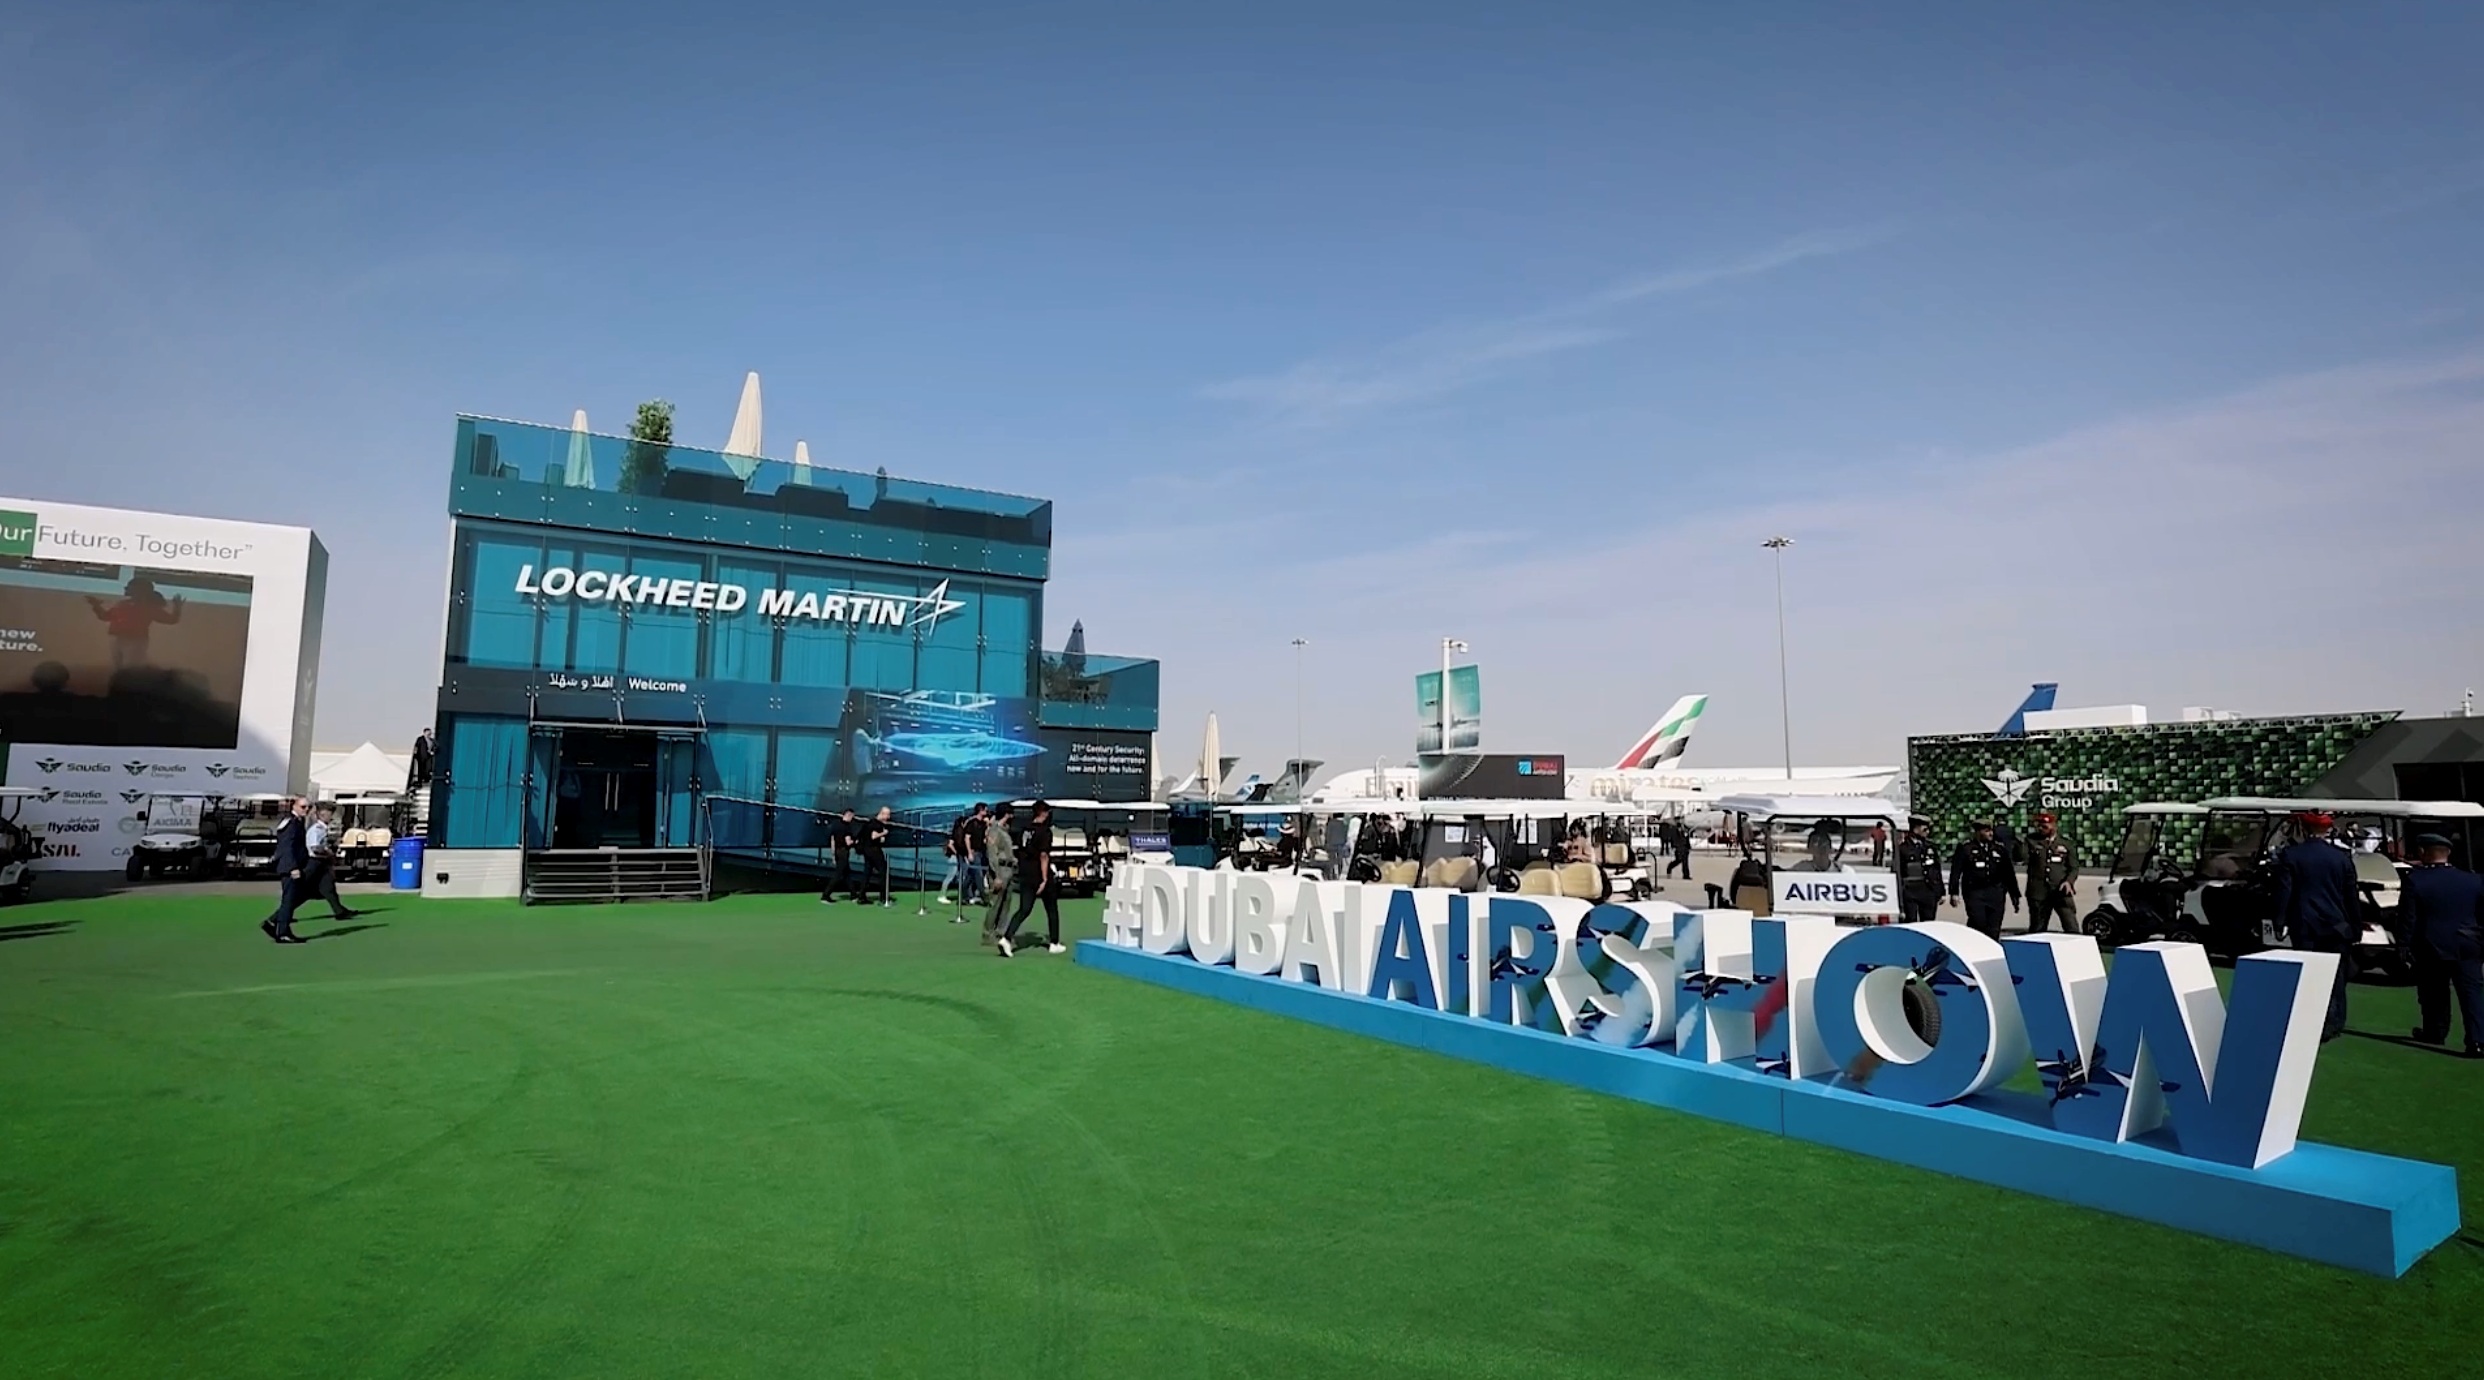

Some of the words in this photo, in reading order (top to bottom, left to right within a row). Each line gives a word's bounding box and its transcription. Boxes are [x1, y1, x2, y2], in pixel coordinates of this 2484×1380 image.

[0, 526, 33, 542] ur
[37, 525, 128, 552] Future,
[514, 564, 747, 612] LOCKHEED
[757, 589, 908, 627] MARTIN
[628, 677, 688, 693] Welcome
[1086, 744, 1114, 755] Century
[66, 763, 111, 773] Saudia
[151, 764, 187, 773] Saudia
[2040, 773, 2120, 793] Saudia
[63, 790, 102, 799] Saudia
[2041, 794, 2093, 813] Group
[48, 822, 100, 834] flyadeal
[1785, 883, 1888, 903] AIRBUS
